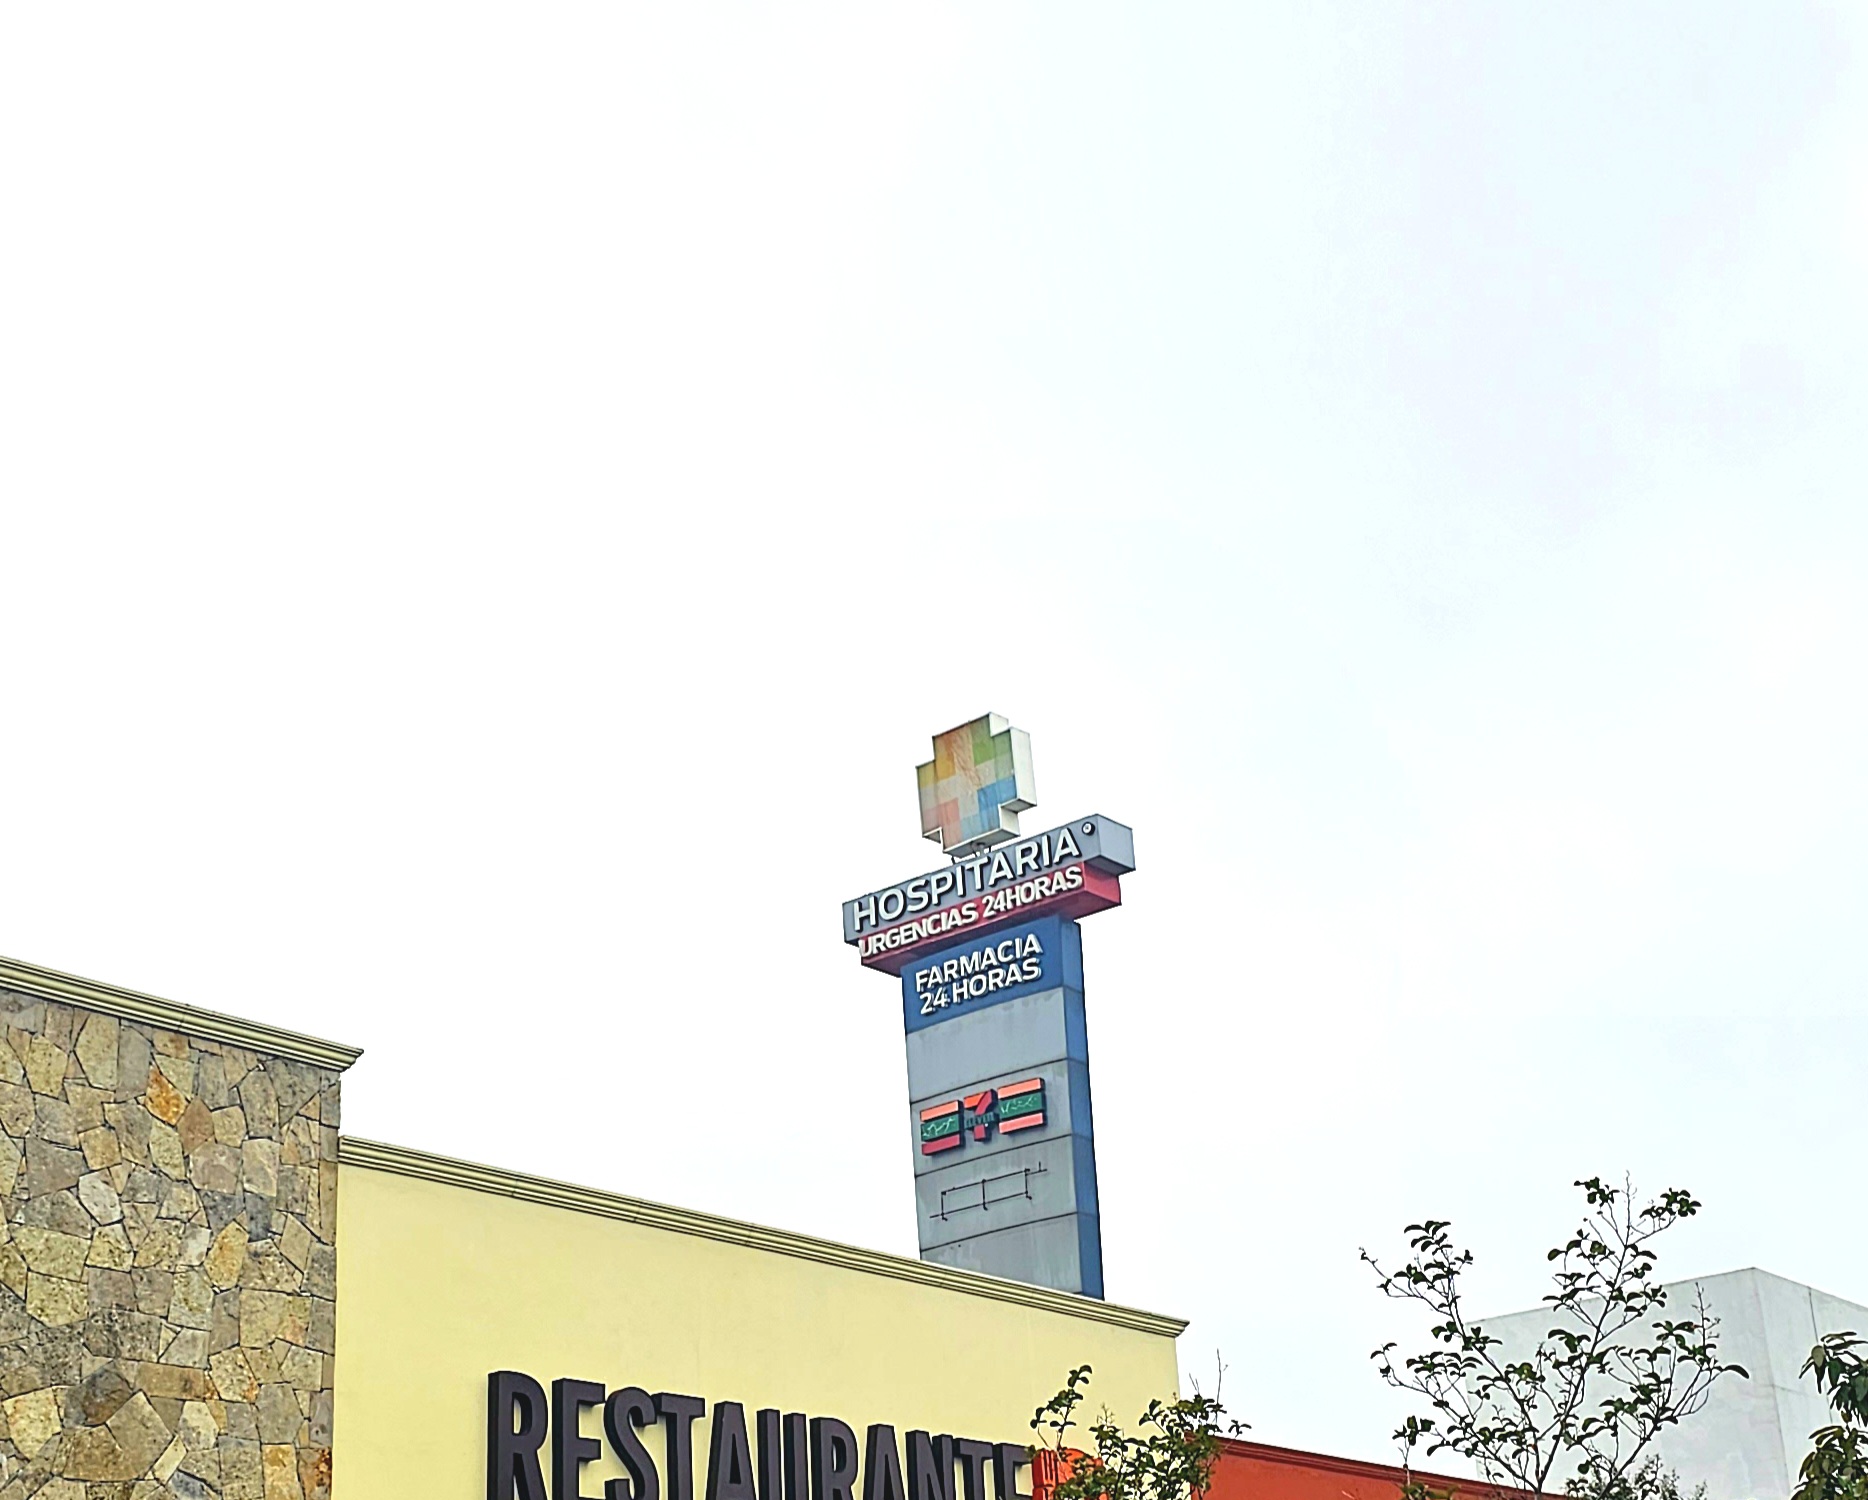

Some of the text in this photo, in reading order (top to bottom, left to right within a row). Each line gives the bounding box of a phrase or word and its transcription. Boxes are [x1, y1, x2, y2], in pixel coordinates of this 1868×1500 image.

[853, 827, 1081, 932] HOSPITARIA
[858, 902, 979, 958] URGENCIAS
[915, 933, 1043, 992] FARMACIA
[919, 957, 1042, 1016] 24 HORAS
